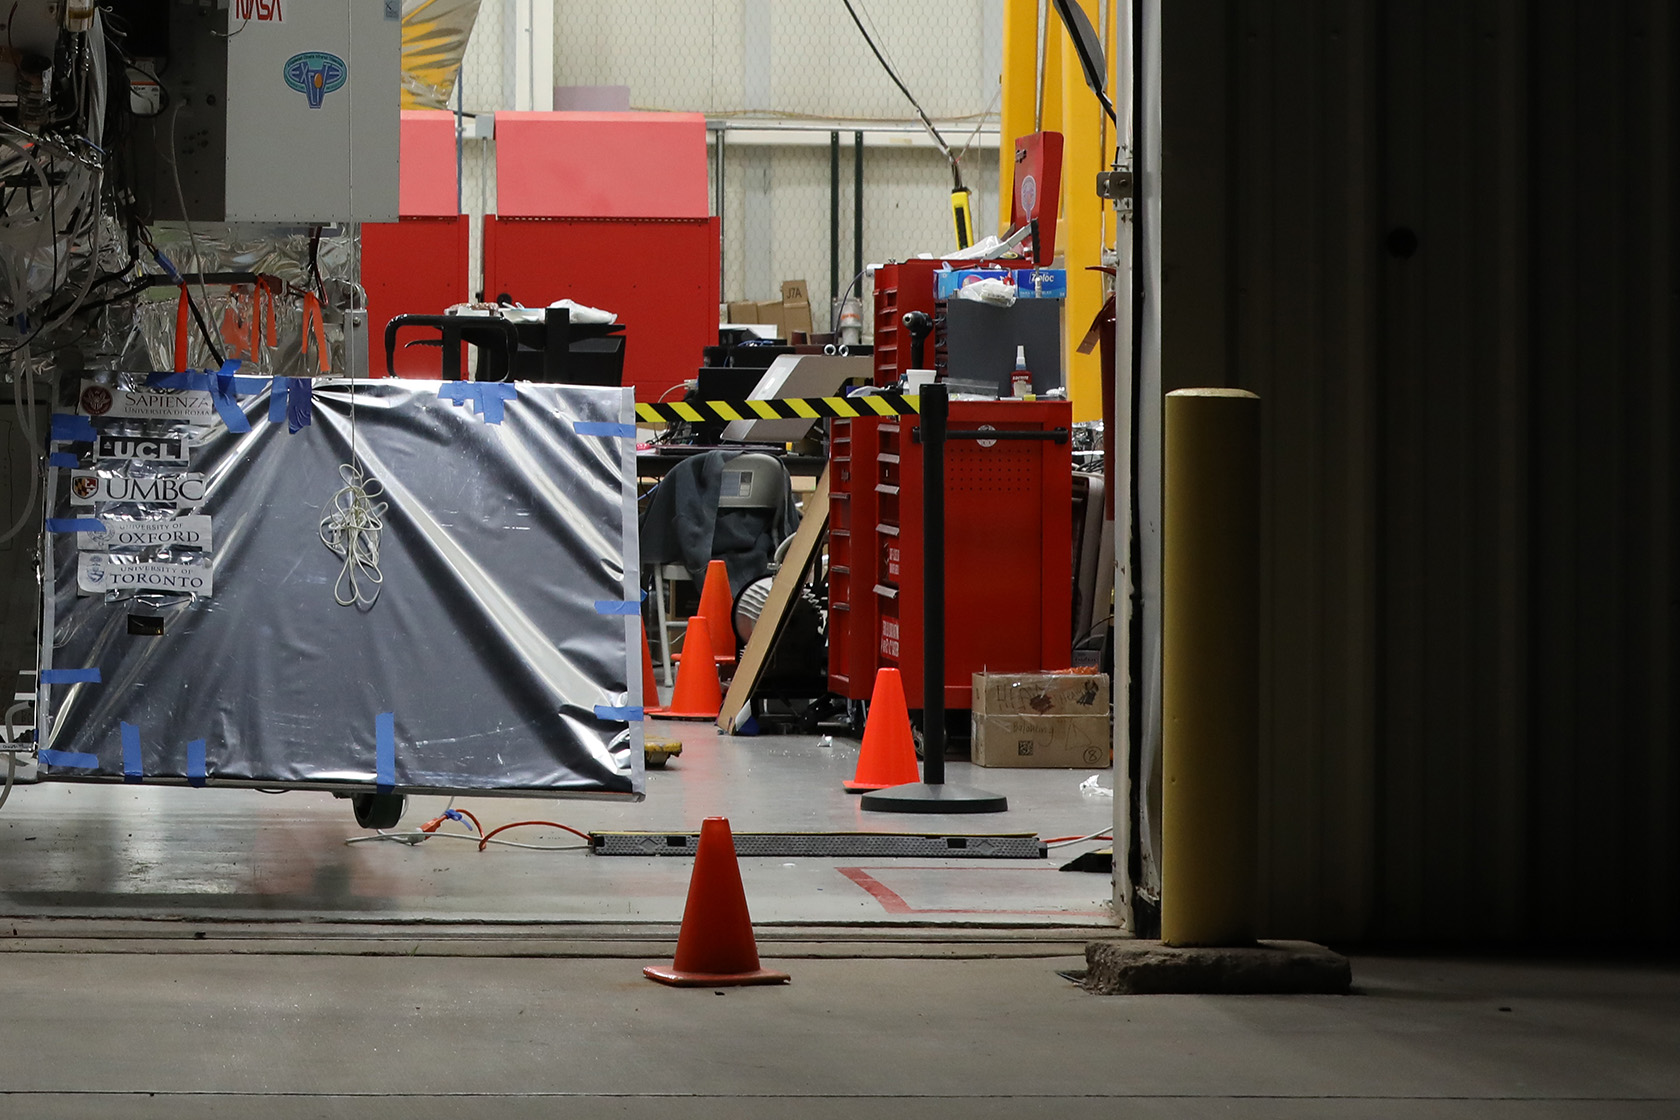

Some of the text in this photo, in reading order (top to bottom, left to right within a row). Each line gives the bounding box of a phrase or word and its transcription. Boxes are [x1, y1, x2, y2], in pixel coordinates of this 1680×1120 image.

[1031, 272, 1055, 283] Zploc
[786, 287, 802, 299] J7A
[124, 392, 209, 408] SAPIENZA
[113, 441, 176, 459] UCL
[106, 478, 204, 501] UMBC
[119, 530, 200, 544] OXFORD
[120, 565, 177, 573] UNIVERSITY
[110, 573, 204, 588] TORONTO
